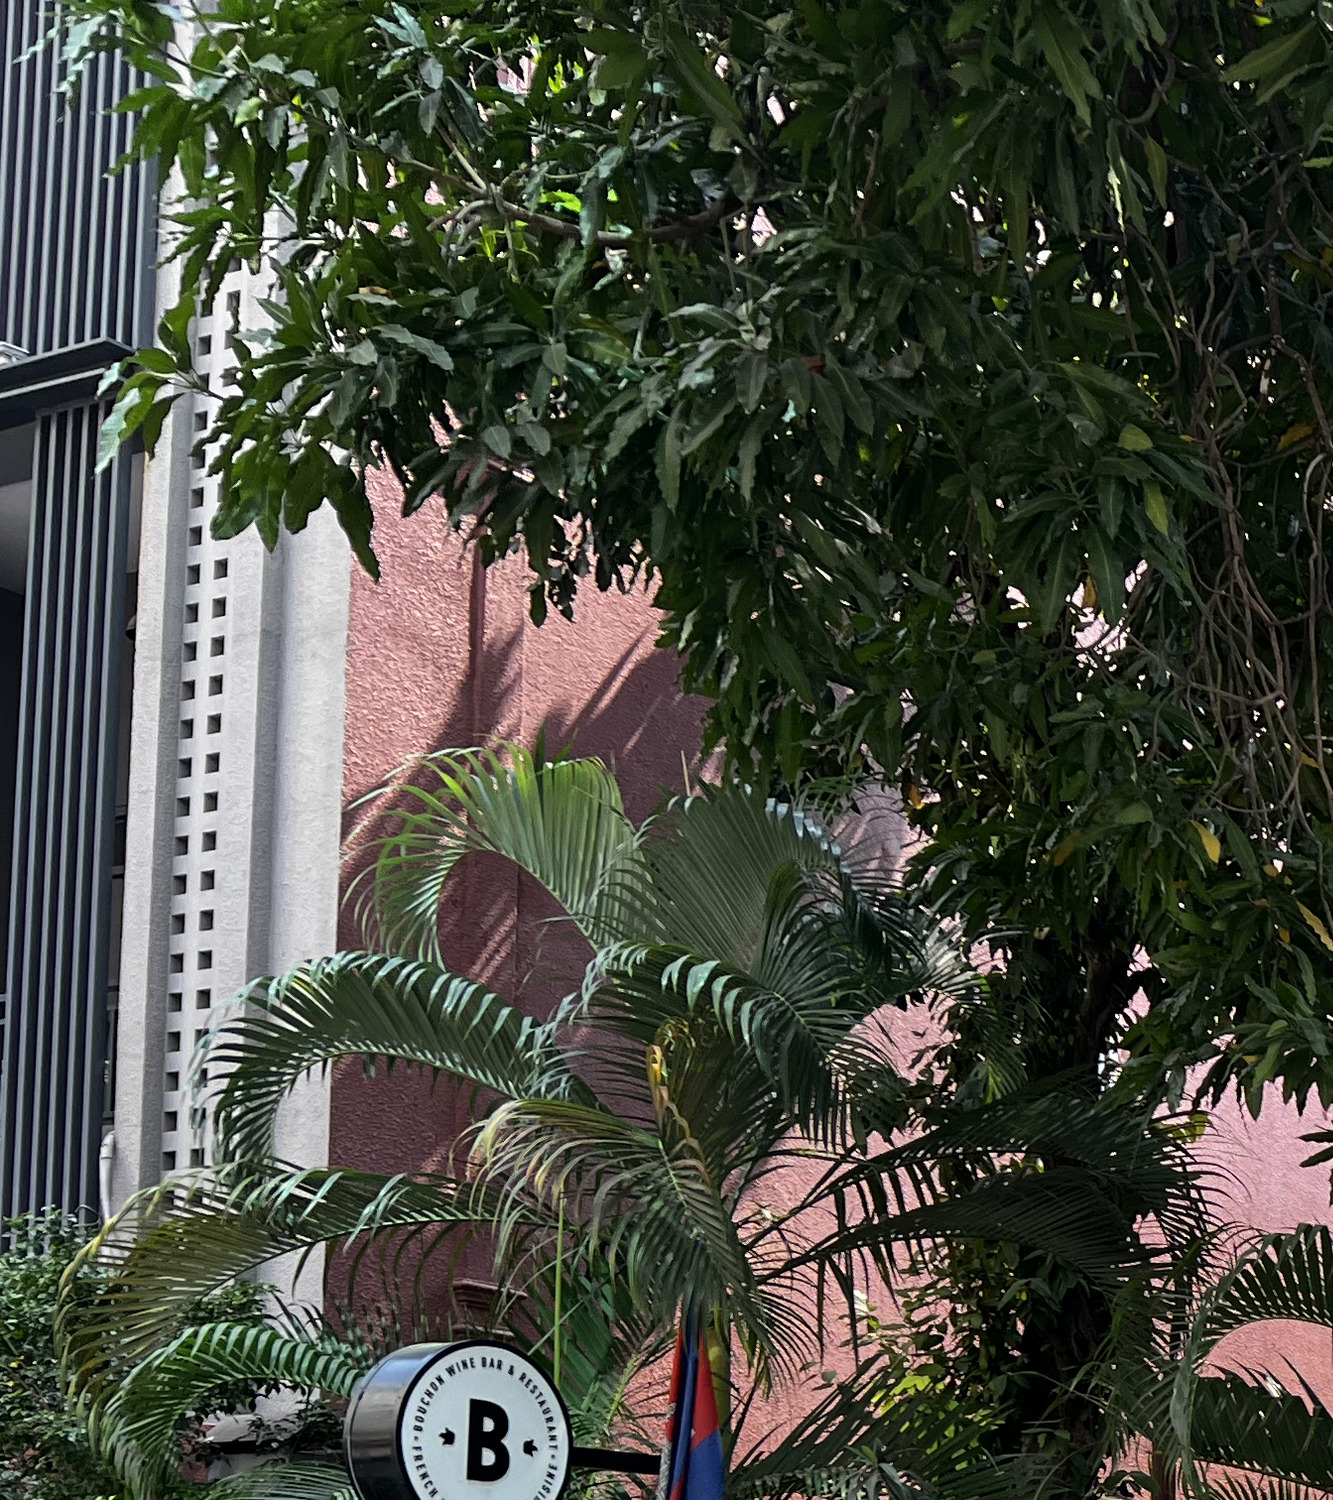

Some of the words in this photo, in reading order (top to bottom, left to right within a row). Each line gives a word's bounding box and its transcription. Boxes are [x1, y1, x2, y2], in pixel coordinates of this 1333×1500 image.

[413, 1373, 446, 1433] BOUCHON
[445, 1357, 476, 1377] WINE
[481, 1356, 503, 1370] BAR
[507, 1365, 515, 1376] &
[518, 1372, 559, 1450] RESTAURANT
[466, 1397, 510, 1482] B
[412, 1445, 439, 1498] FRENCH
